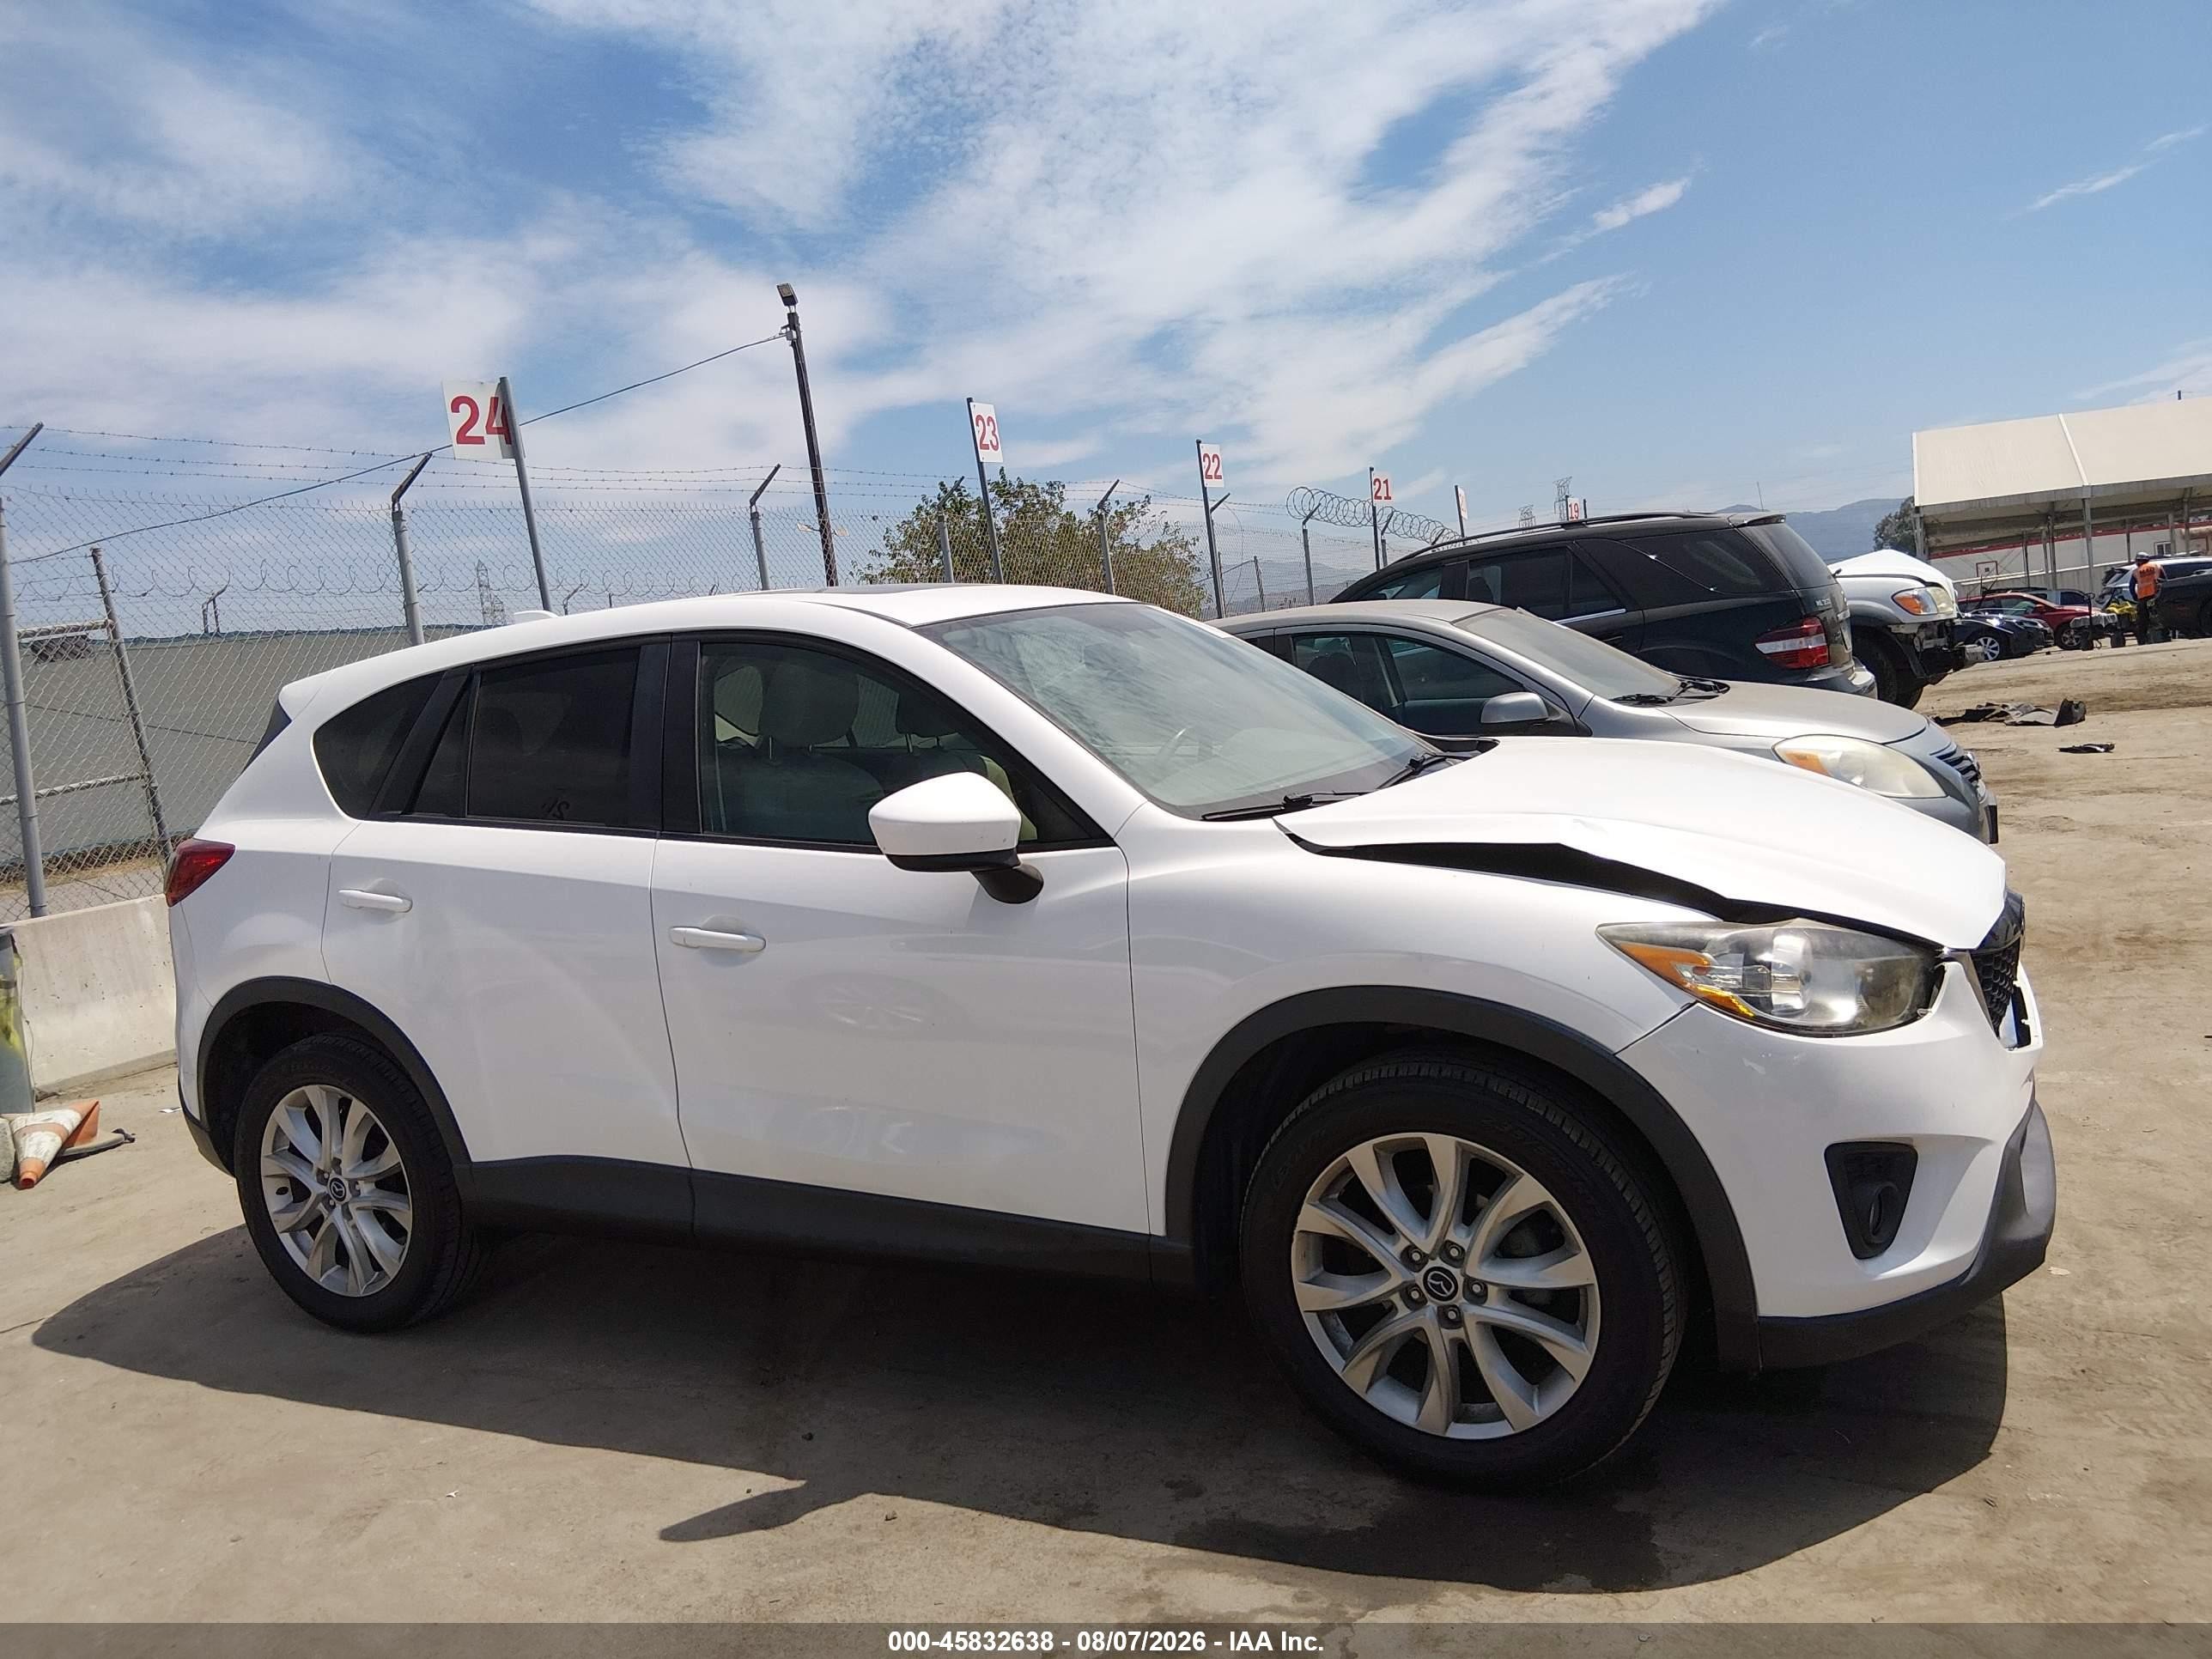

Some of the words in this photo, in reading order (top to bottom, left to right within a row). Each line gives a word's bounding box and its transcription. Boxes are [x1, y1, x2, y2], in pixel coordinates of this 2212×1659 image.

[450, 395, 513, 445] 24
[975, 414, 1000, 452] 23
[1202, 453, 1223, 480] 22
[1372, 477, 1392, 501] 21
[1568, 502, 1579, 520] 19
